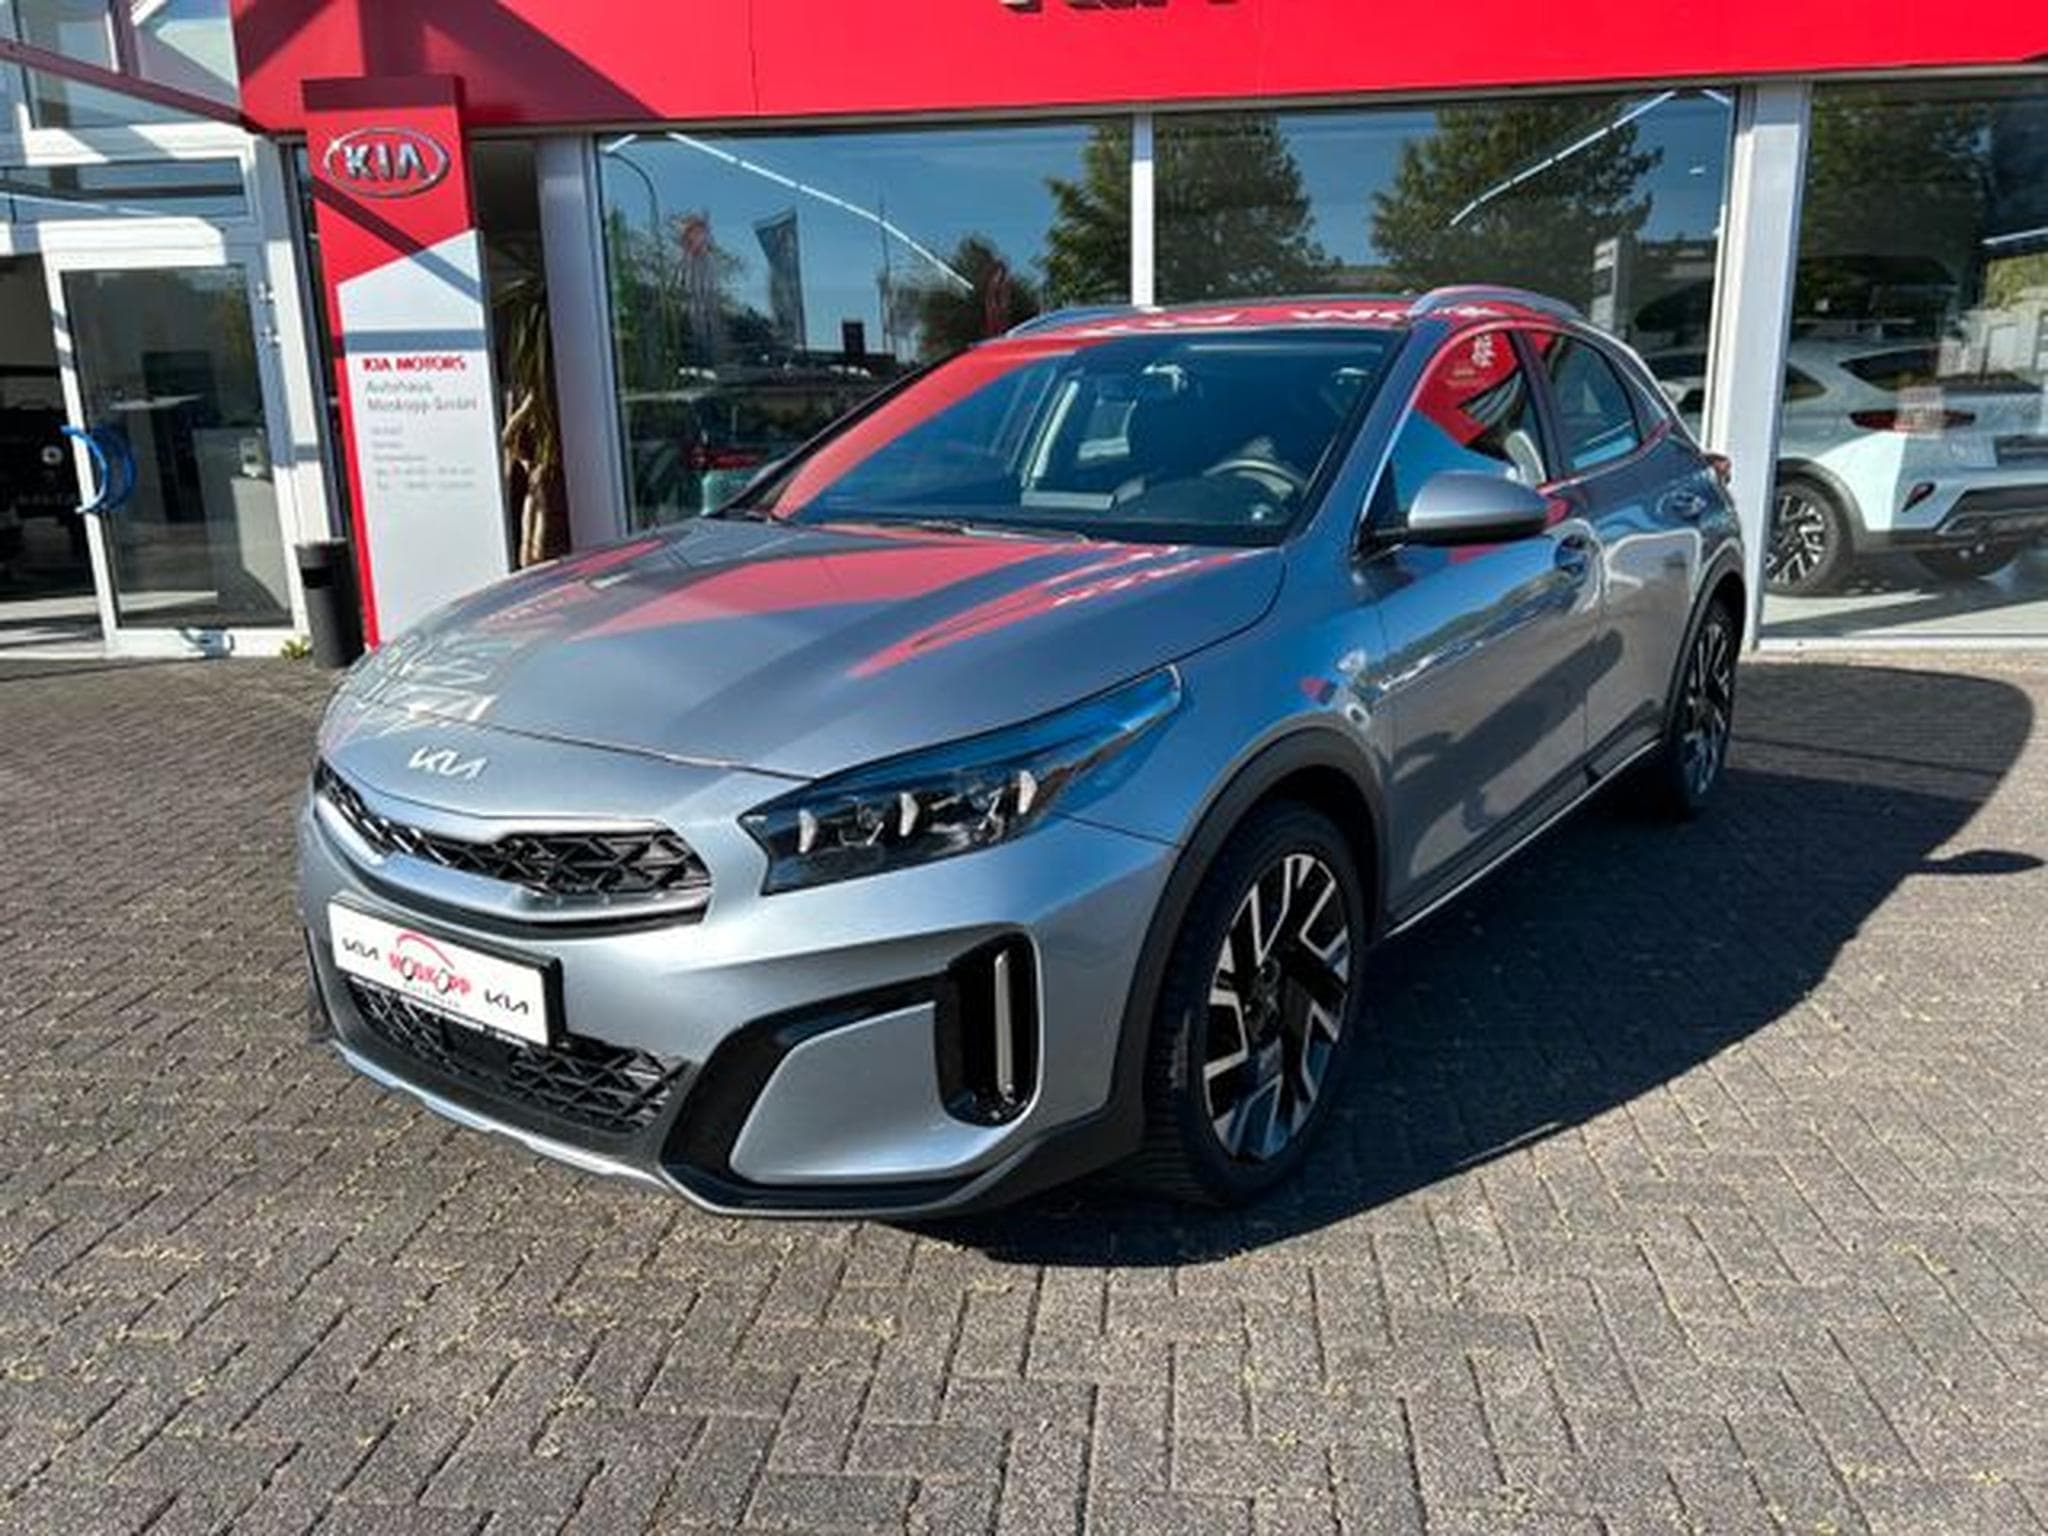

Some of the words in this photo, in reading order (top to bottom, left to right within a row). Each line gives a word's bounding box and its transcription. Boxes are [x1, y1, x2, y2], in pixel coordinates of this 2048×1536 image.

[343, 142, 428, 180] KIA
[363, 357, 393, 371] KIA
[396, 355, 466, 371] MOTORS
[366, 381, 433, 393] Autohaus
[408, 746, 487, 780] KIA
[342, 937, 379, 960] KIA
[484, 988, 529, 1015] KIA
